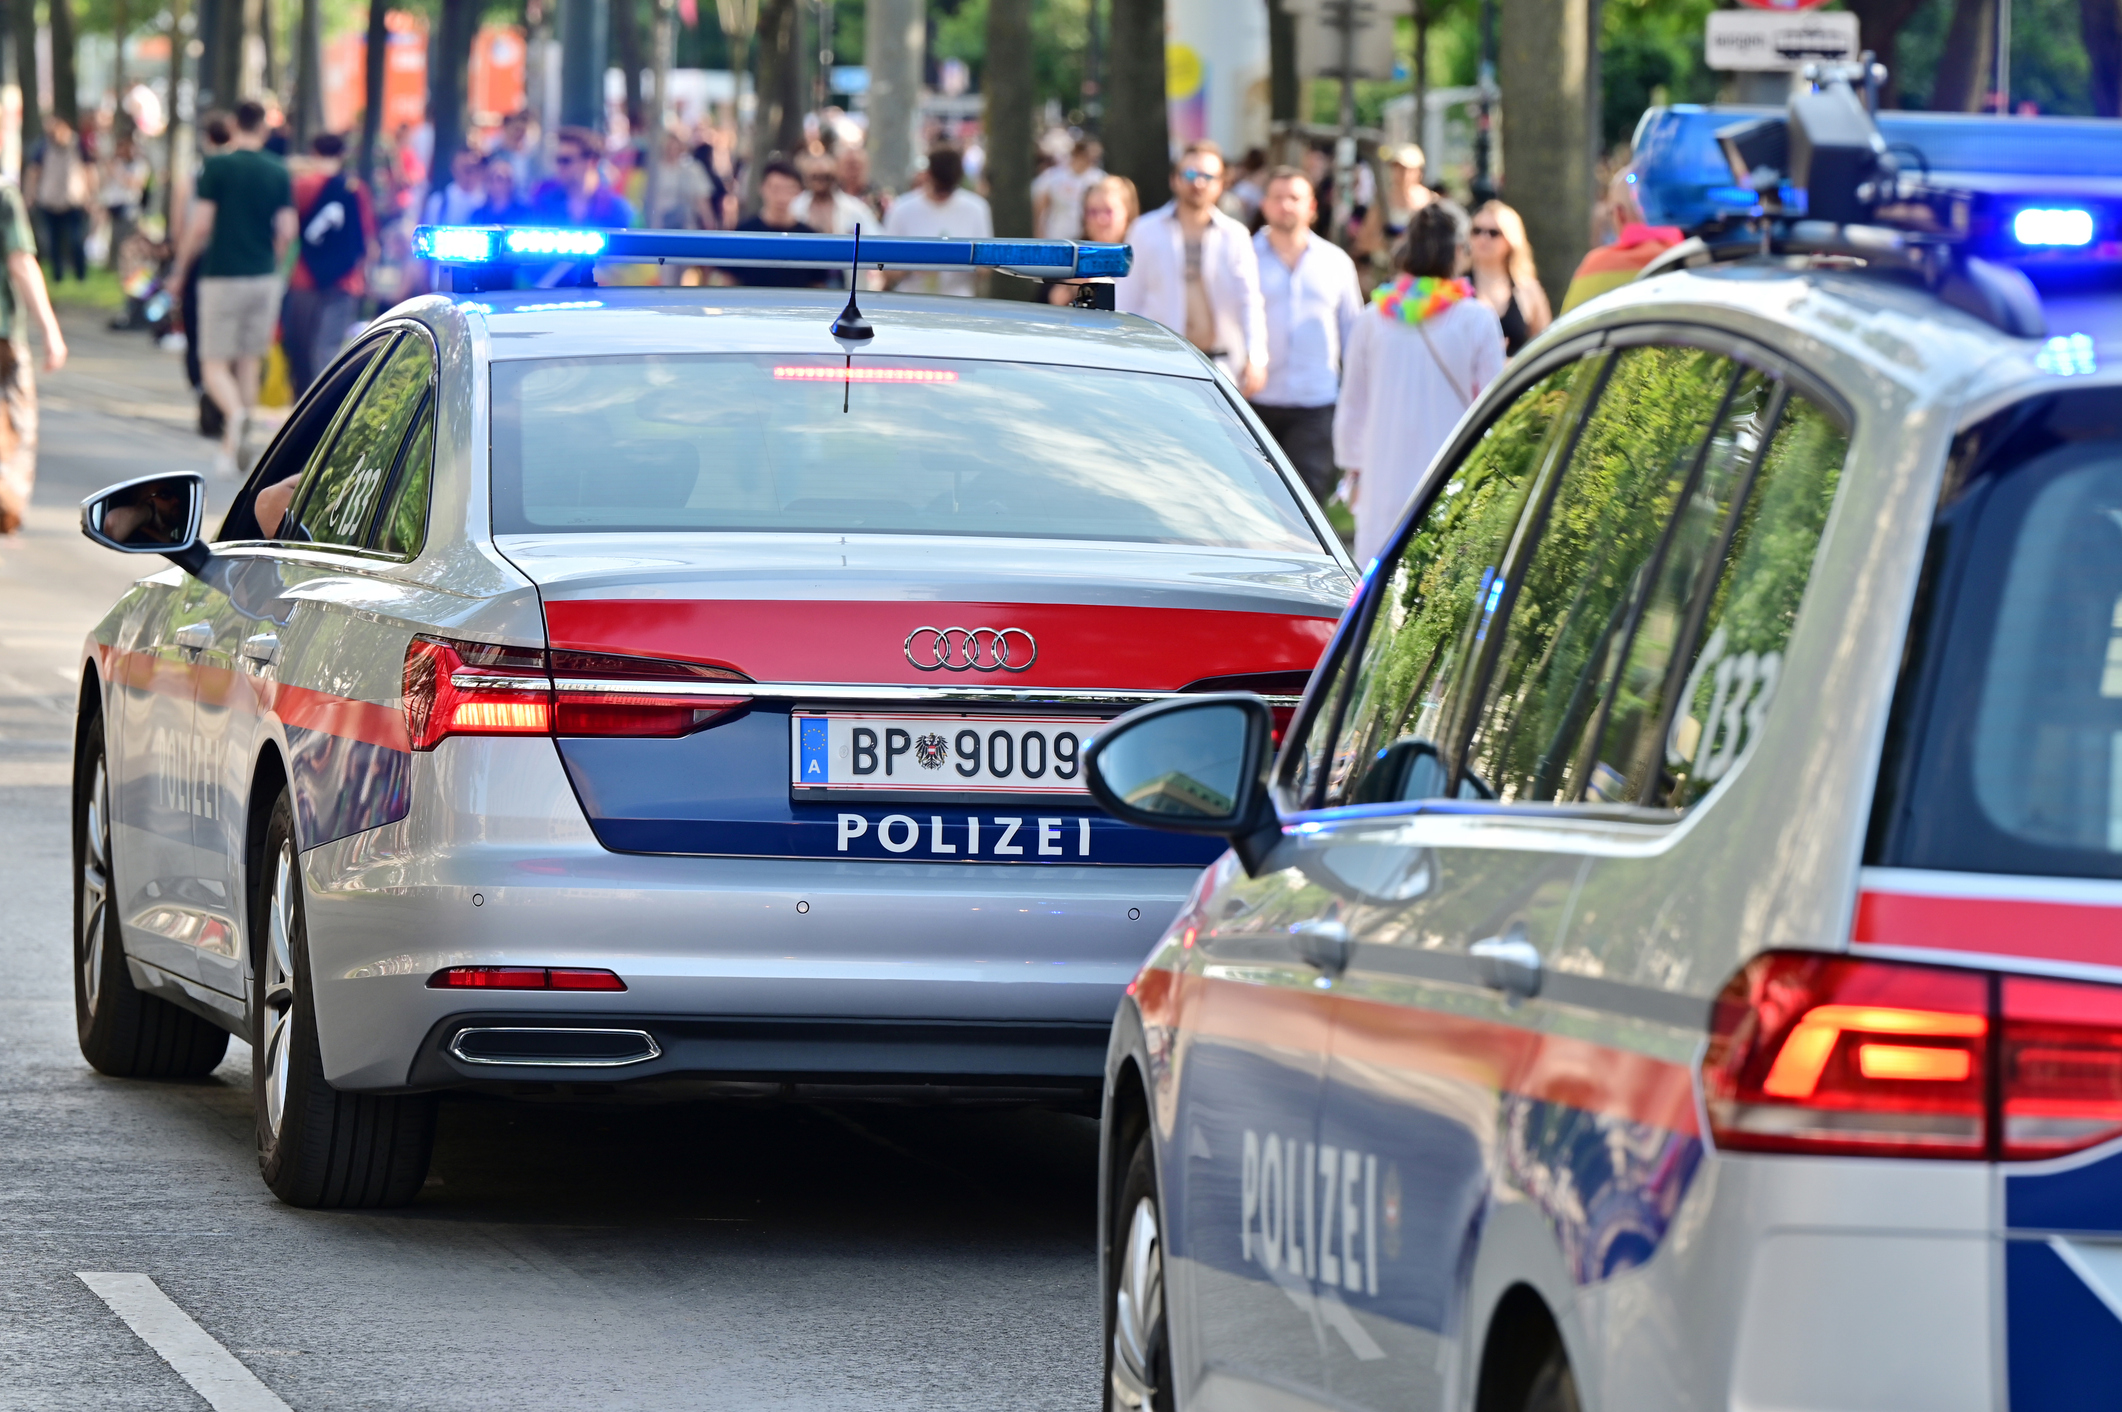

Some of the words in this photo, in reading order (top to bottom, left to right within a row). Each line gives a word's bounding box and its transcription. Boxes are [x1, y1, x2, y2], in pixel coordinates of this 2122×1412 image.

[337, 468, 381, 536] 133
[158, 726, 219, 821] POLIZEI
[807, 759, 821, 774] A
[852, 728, 911, 776] BP
[954, 729, 1079, 780] 9009
[837, 813, 1090, 856] POLIZEI
[1241, 1129, 1378, 1297] POLIZEI
